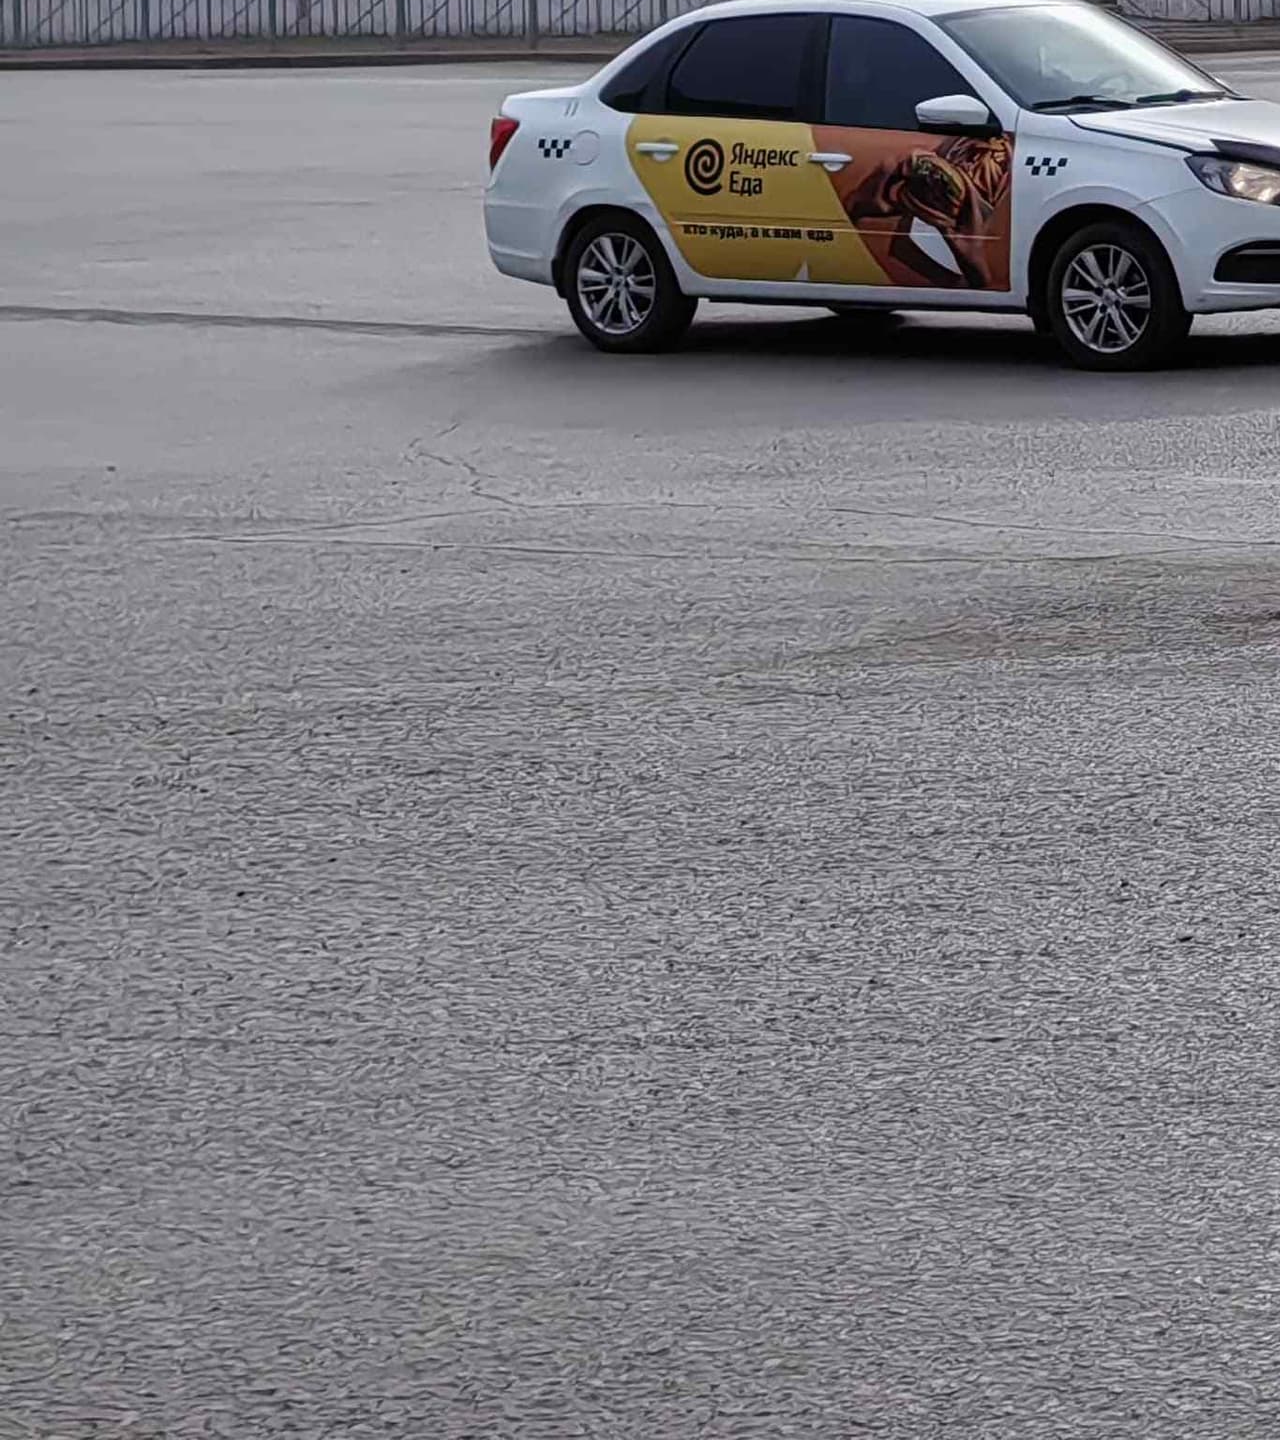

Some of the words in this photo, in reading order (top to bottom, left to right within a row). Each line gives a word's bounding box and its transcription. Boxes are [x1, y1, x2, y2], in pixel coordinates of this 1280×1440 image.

[730, 142, 799, 168] Яндекс
[729, 171, 762, 197] Еда
[683, 224, 707, 235] кто
[710, 225, 748, 240] куда,
[751, 227, 759, 238] а
[773, 229, 802, 239] вам
[806, 230, 833, 242] еда
